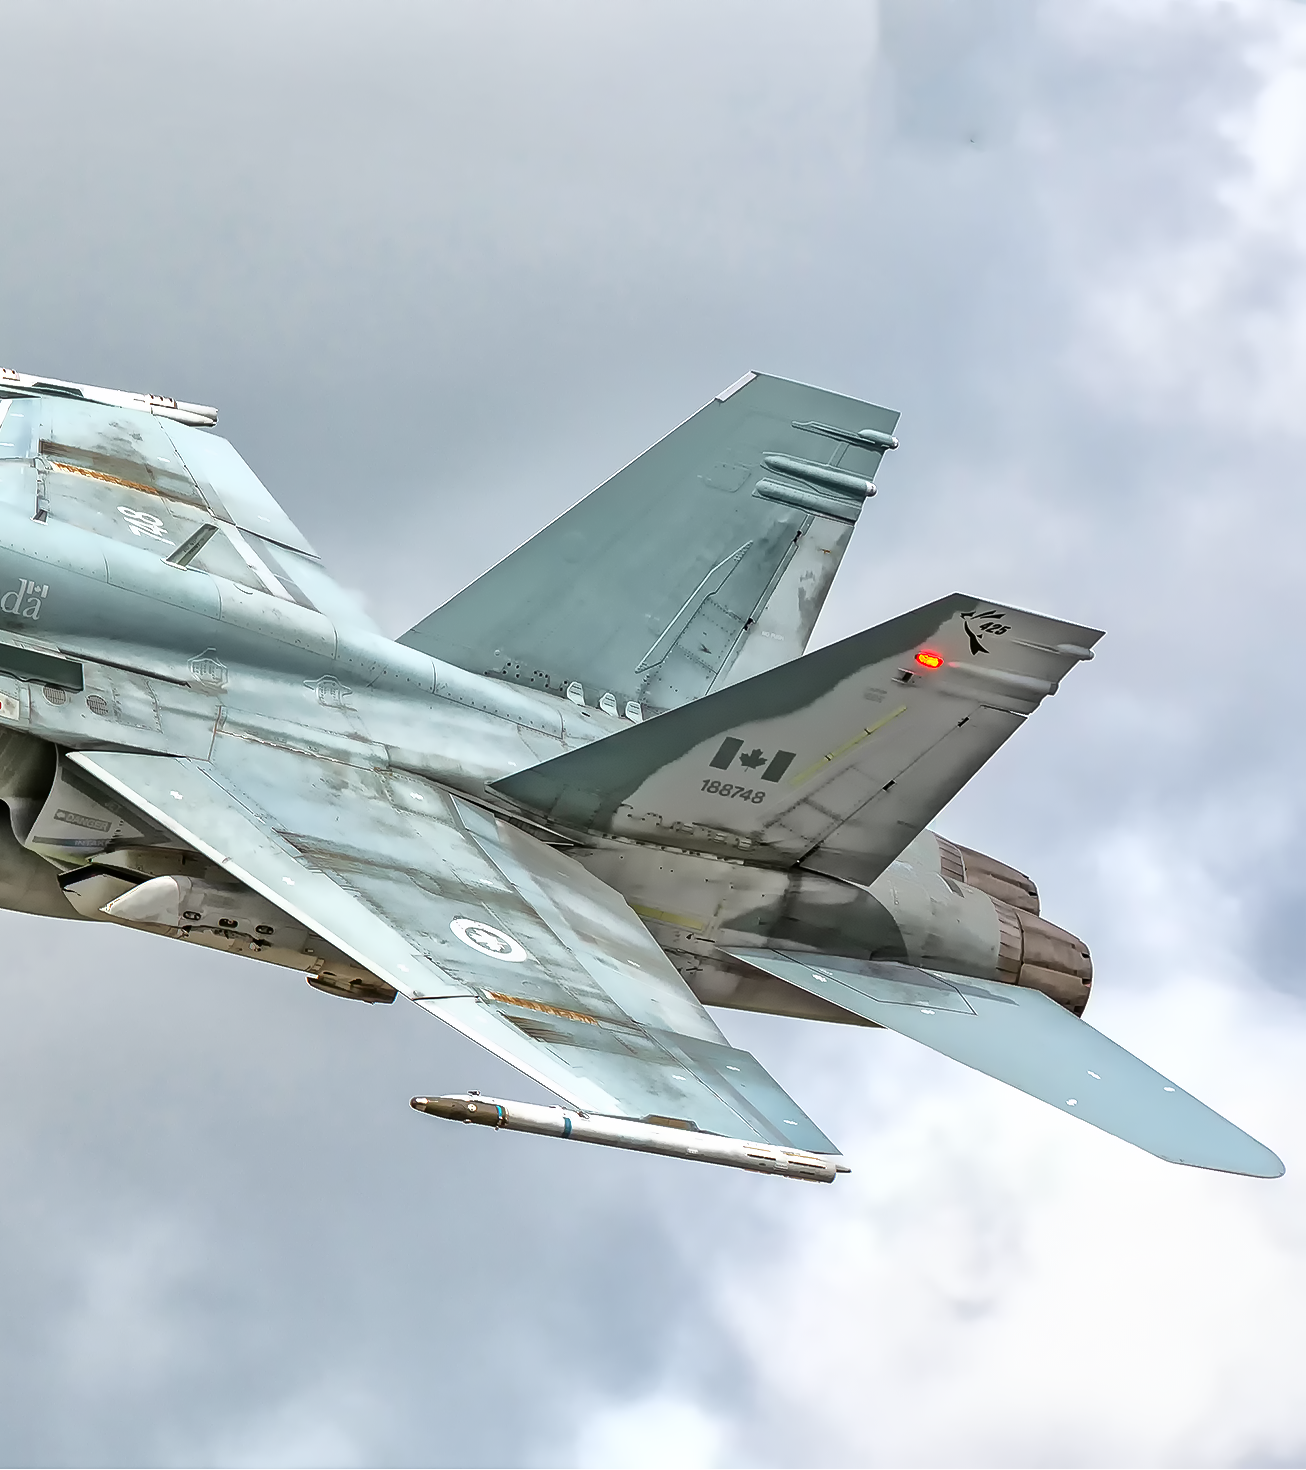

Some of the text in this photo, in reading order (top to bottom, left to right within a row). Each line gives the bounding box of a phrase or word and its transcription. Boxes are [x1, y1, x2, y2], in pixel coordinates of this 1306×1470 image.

[979, 622, 1012, 635] 425
[700, 779, 766, 804] 188748
[65, 813, 108, 831] DANGER
